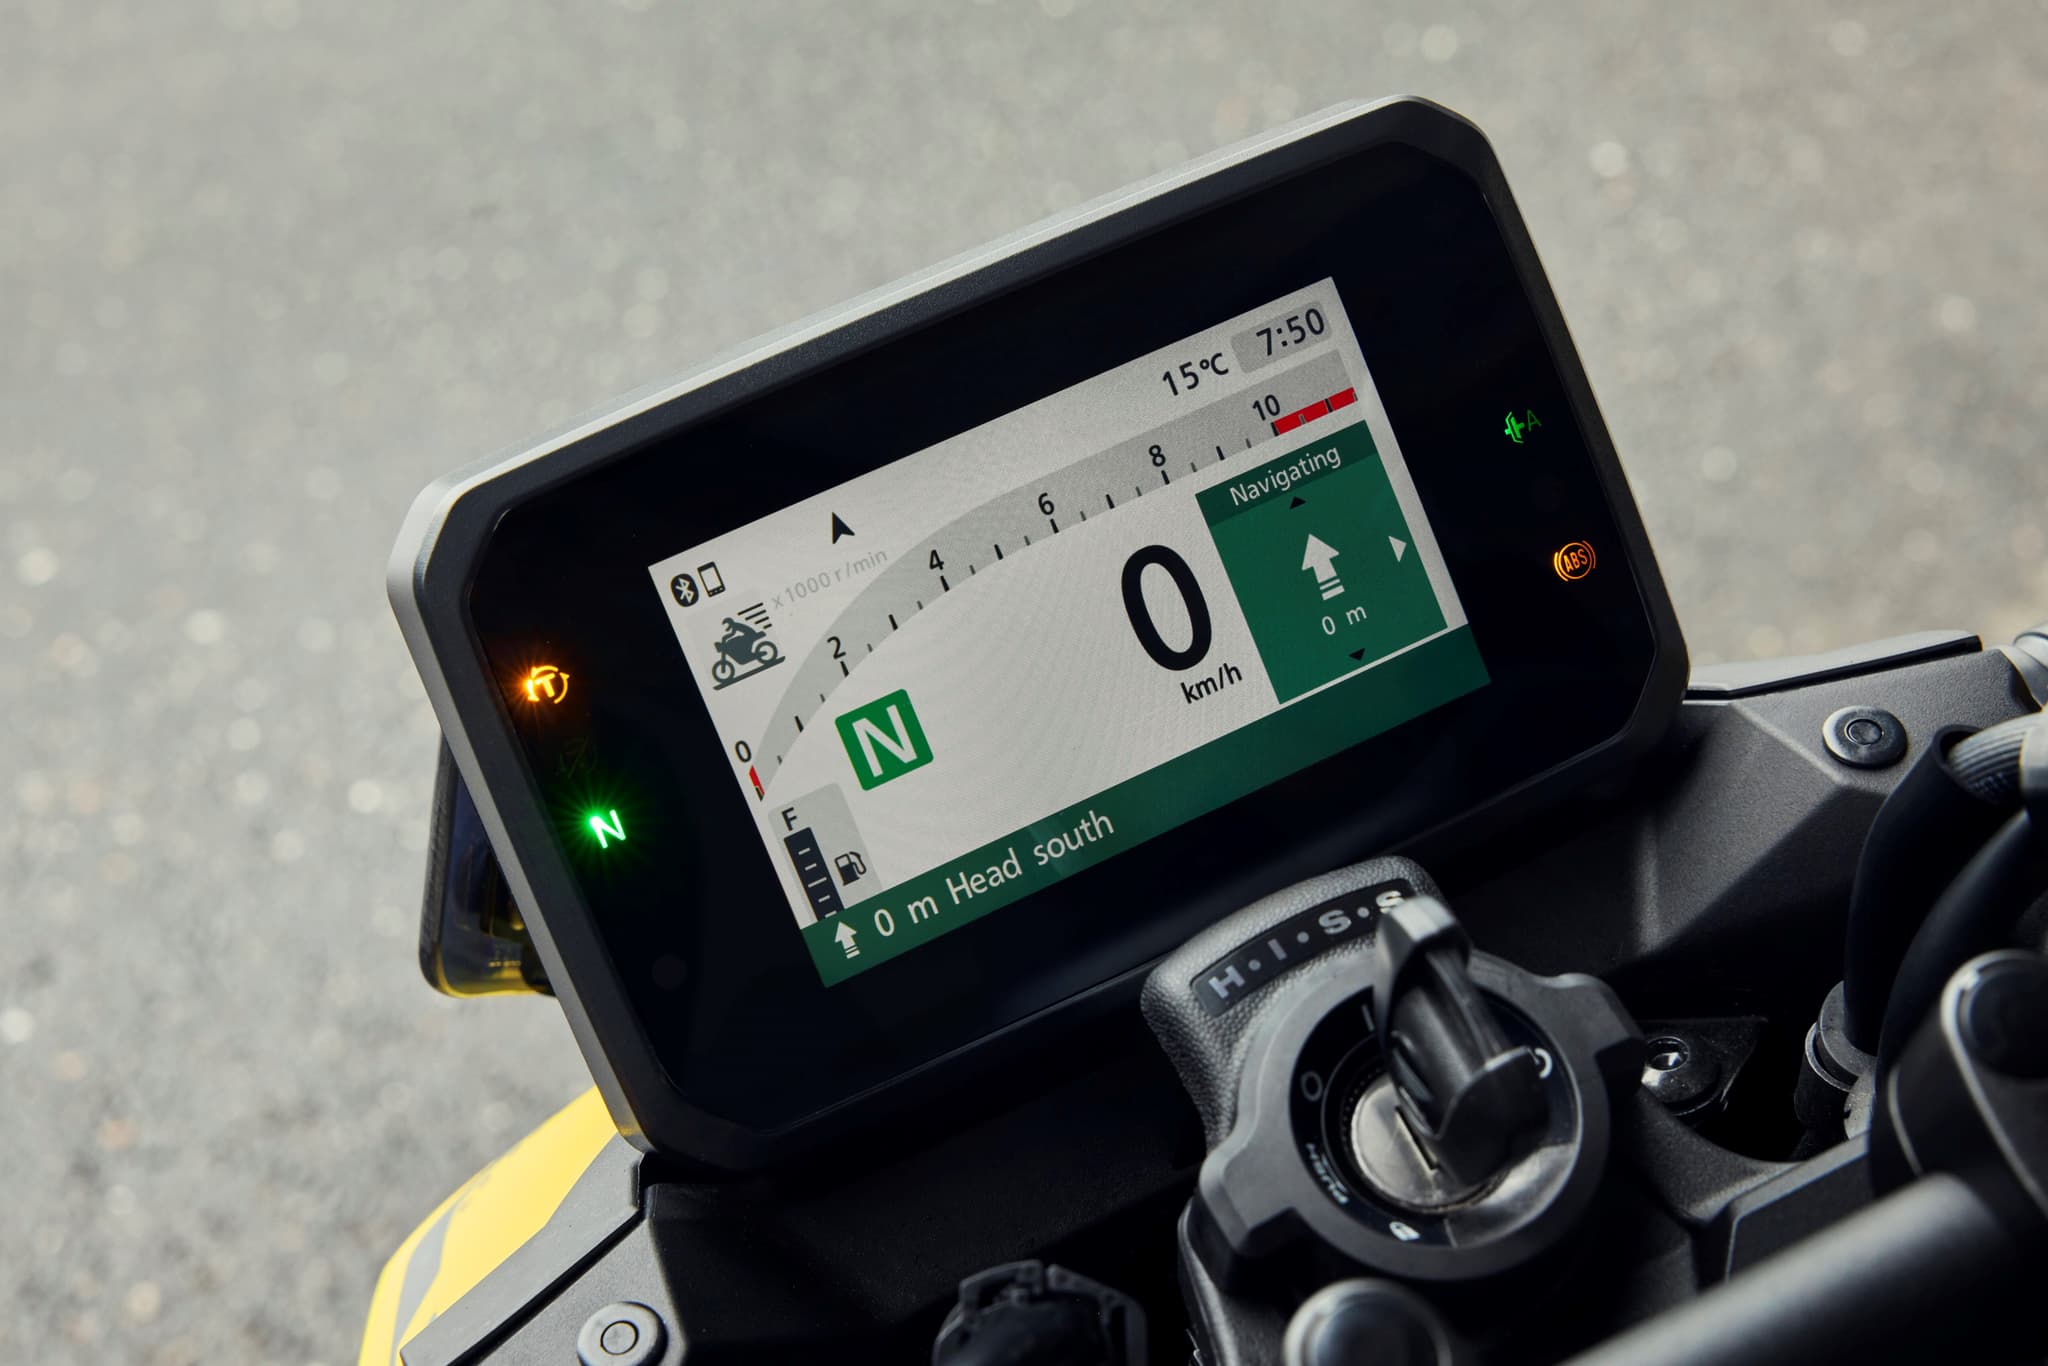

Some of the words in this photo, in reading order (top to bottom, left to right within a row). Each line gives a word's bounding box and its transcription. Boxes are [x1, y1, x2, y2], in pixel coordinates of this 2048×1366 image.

[1256, 308, 1325, 356] 7:50
[1162, 353, 1229, 396] 15°C
[1252, 394, 1281, 421] 10
[1526, 409, 1542, 432] A
[1148, 444, 1166, 467] 8
[1229, 446, 1342, 506] Navigating
[1038, 493, 1055, 515] 6
[834, 551, 888, 582] r/min
[928, 550, 944, 571] 4
[1563, 549, 1588, 573] ABS
[1121, 544, 1213, 672] 0
[1321, 616, 1336, 636] 0
[1346, 605, 1367, 626] m
[827, 636, 846, 659] 2
[1180, 662, 1243, 704] km/h
[734, 740, 752, 763] 0
[852, 703, 918, 778] N
[590, 809, 626, 849] N
[781, 807, 799, 831] F
[873, 908, 895, 937] 0
[906, 895, 939, 924] m
[945, 848, 1024, 905] Head
[1032, 810, 1115, 866] south
